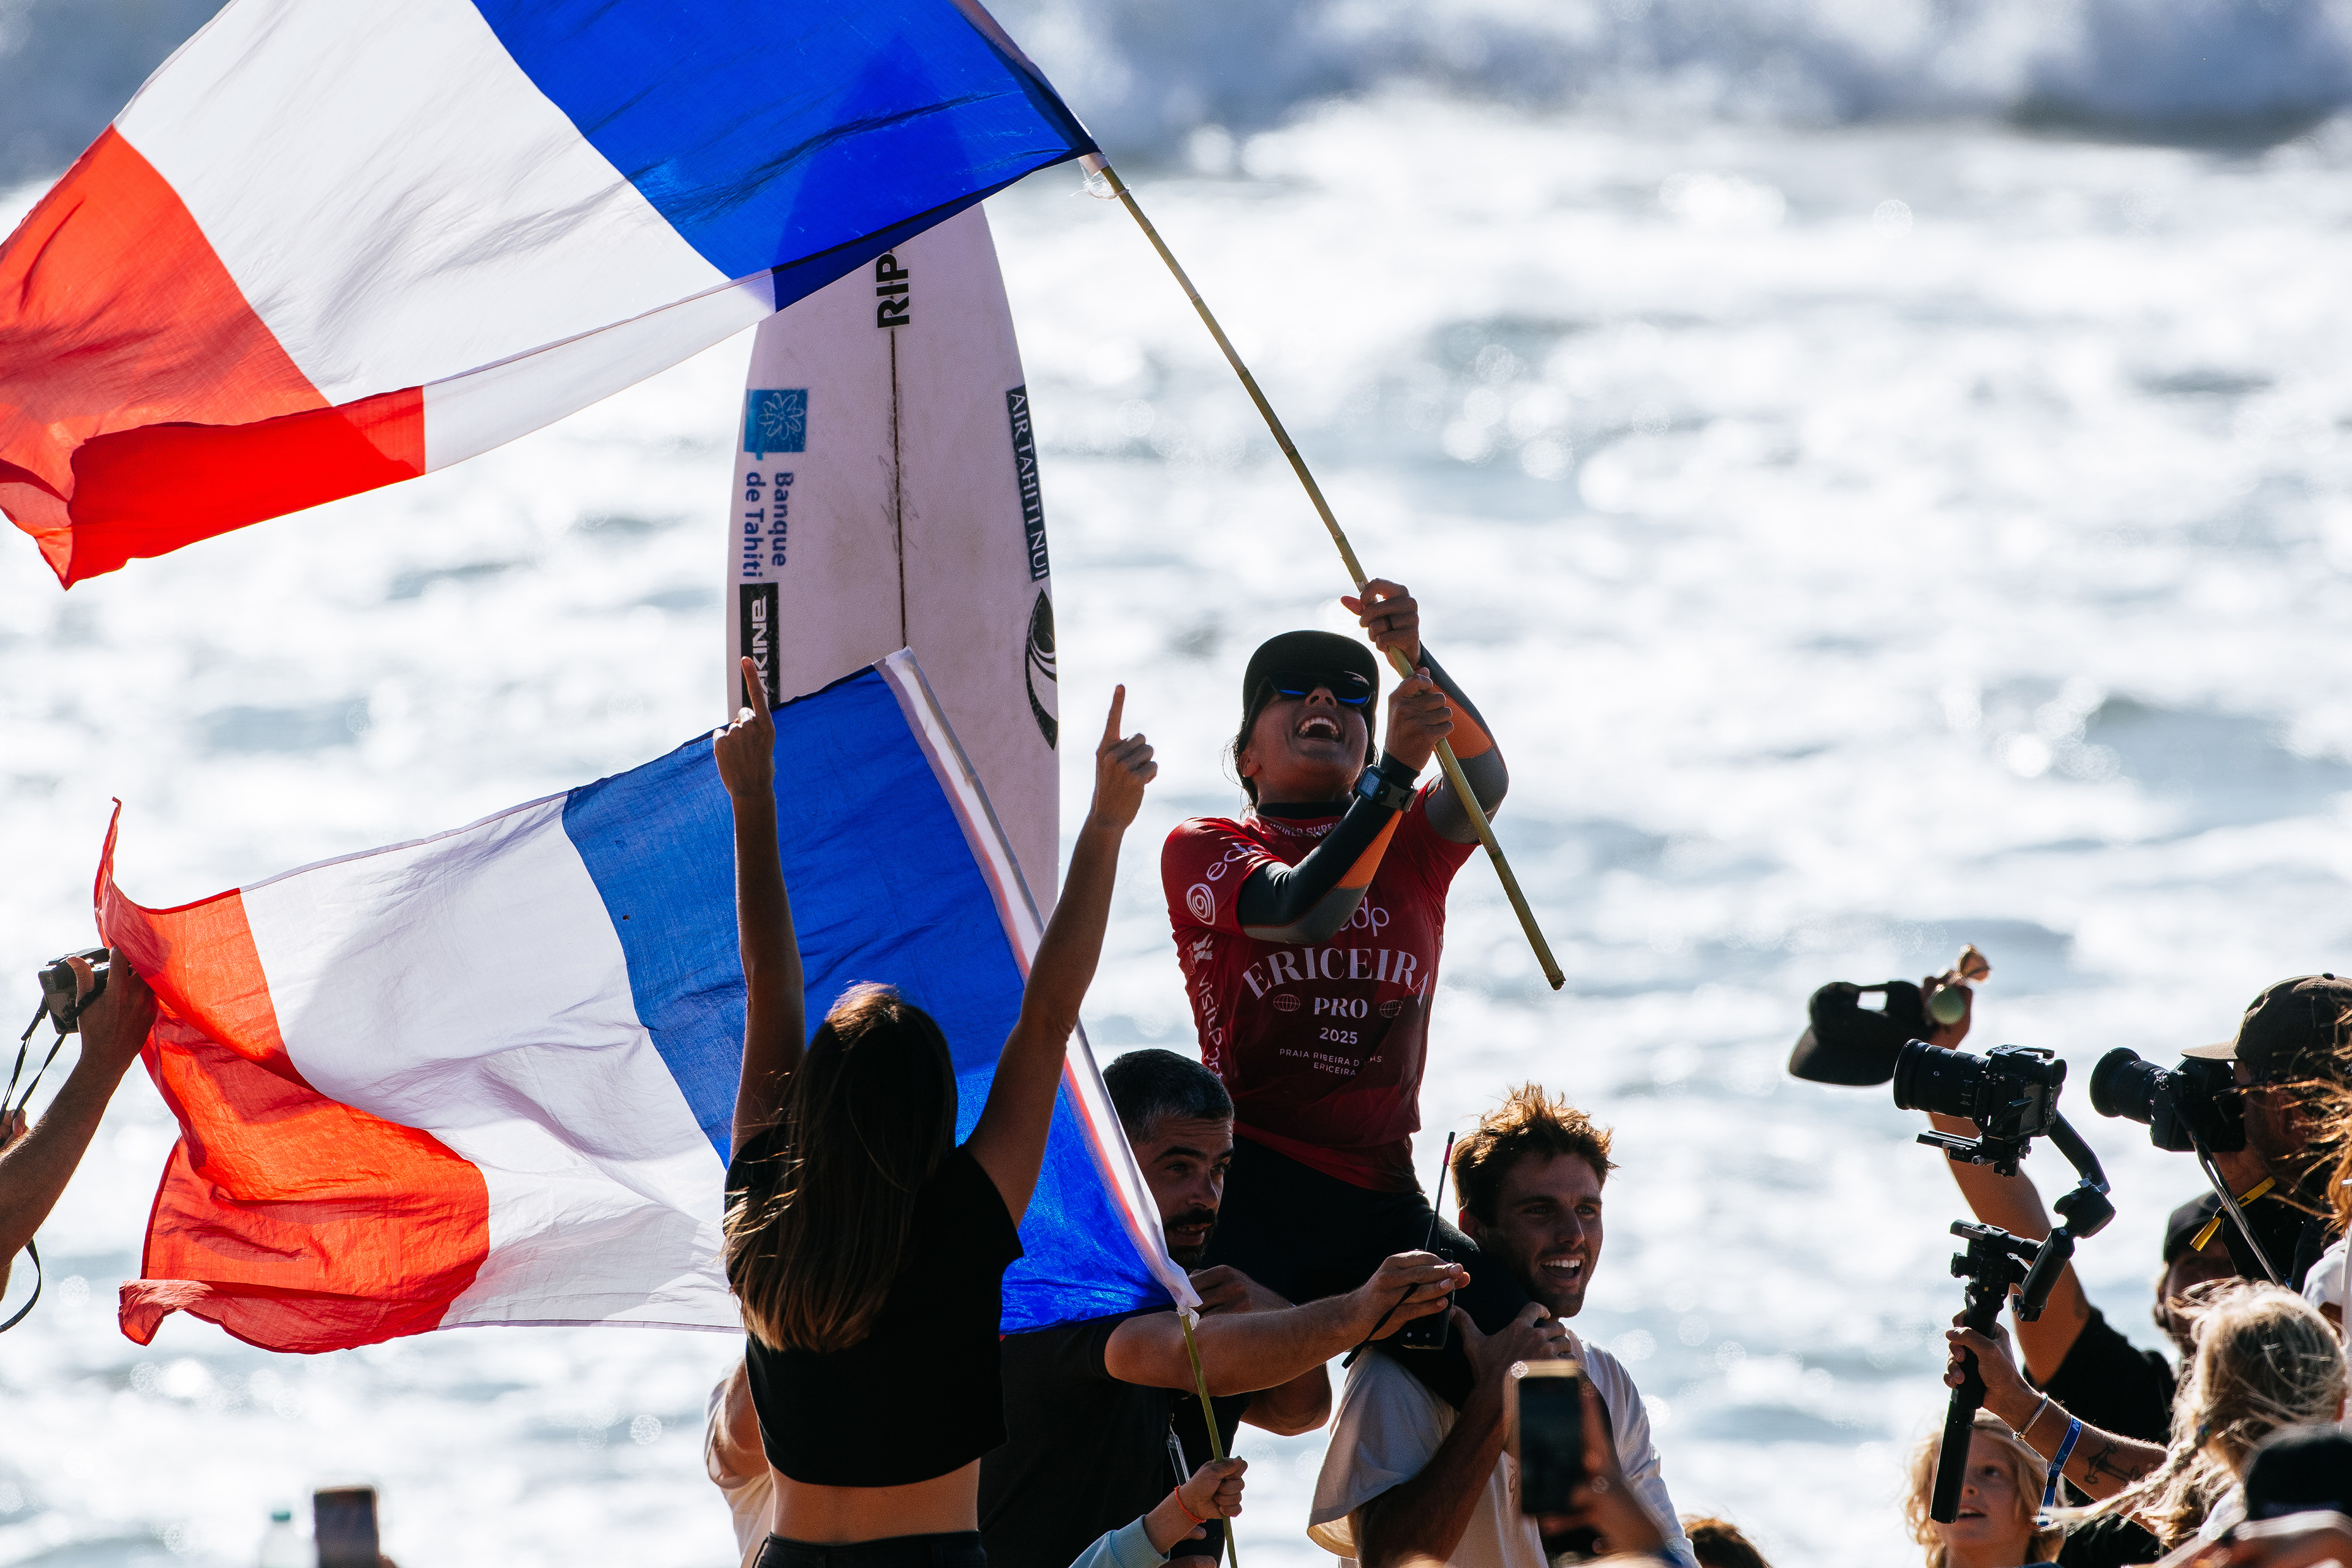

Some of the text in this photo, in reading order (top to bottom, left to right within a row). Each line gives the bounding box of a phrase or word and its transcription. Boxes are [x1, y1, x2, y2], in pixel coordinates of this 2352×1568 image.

[876, 253, 910, 328] RIP
[1011, 393, 1047, 577] AIR TAHITI NUI
[742, 472, 766, 577] de Tahiti
[767, 472, 794, 567] Banque
[1242, 948, 1429, 1009] ERICEIRA
[1314, 997, 1368, 1019] PRO
[1280, 1048, 1310, 1058] PRAIA
[1313, 1052, 1351, 1066] RIBEIRA
[1319, 1027, 1358, 1044] 2025
[1313, 1062, 1356, 1076] ERICEIRA
